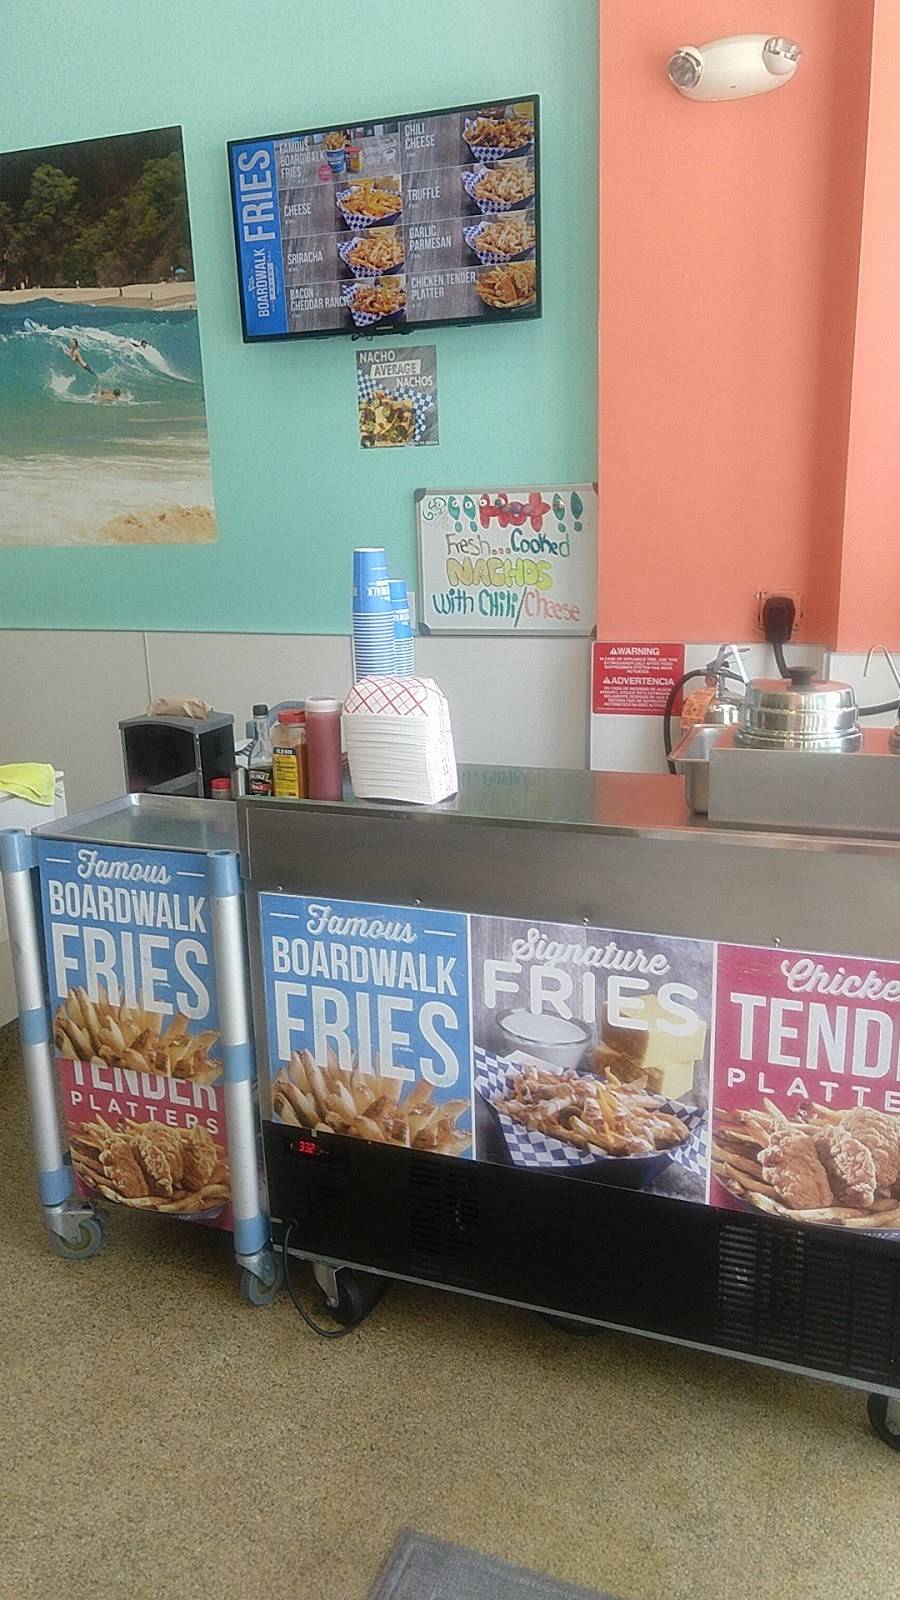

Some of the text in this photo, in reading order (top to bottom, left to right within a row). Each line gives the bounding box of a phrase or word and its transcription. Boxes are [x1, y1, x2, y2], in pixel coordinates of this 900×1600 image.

[404, 122, 425, 137] CHILI
[405, 134, 435, 150] CHEESE
[281, 166, 302, 179] FRIES
[407, 185, 441, 201] TRUFFLE
[284, 202, 312, 217] CHEESE
[237, 149, 276, 318] BOARDWALK FRIES
[408, 224, 437, 239] GARLIC
[409, 235, 452, 251] PARMESAN
[287, 250, 324, 265] SRIRACHA
[411, 271, 476, 289] CHICKEN TENDER
[289, 287, 314, 300] BACON
[411, 287, 445, 301] PLATTER
[290, 299, 323, 312] CHEDDAR
[359, 350, 396, 363] NACHO
[374, 362, 417, 377] AVERAGE
[396, 375, 433, 387] NACHOS
[445, 556, 553, 591] NACHOS
[617, 647, 660, 656] WARNING
[608, 677, 675, 686] ADVERTENCIA
[76, 848, 172, 886] Famous
[48, 879, 207, 935] BOARDWALK
[306, 903, 417, 944] Famous
[511, 927, 671, 976] Signature
[51, 922, 211, 1020] FRIES
[271, 935, 458, 997] BOARDWALK
[483, 958, 700, 1037] FRIES
[274, 980, 460, 1089] FRIES
[730, 991, 900, 1082] TEND
[70, 1090, 220, 1135] PLATTERS
